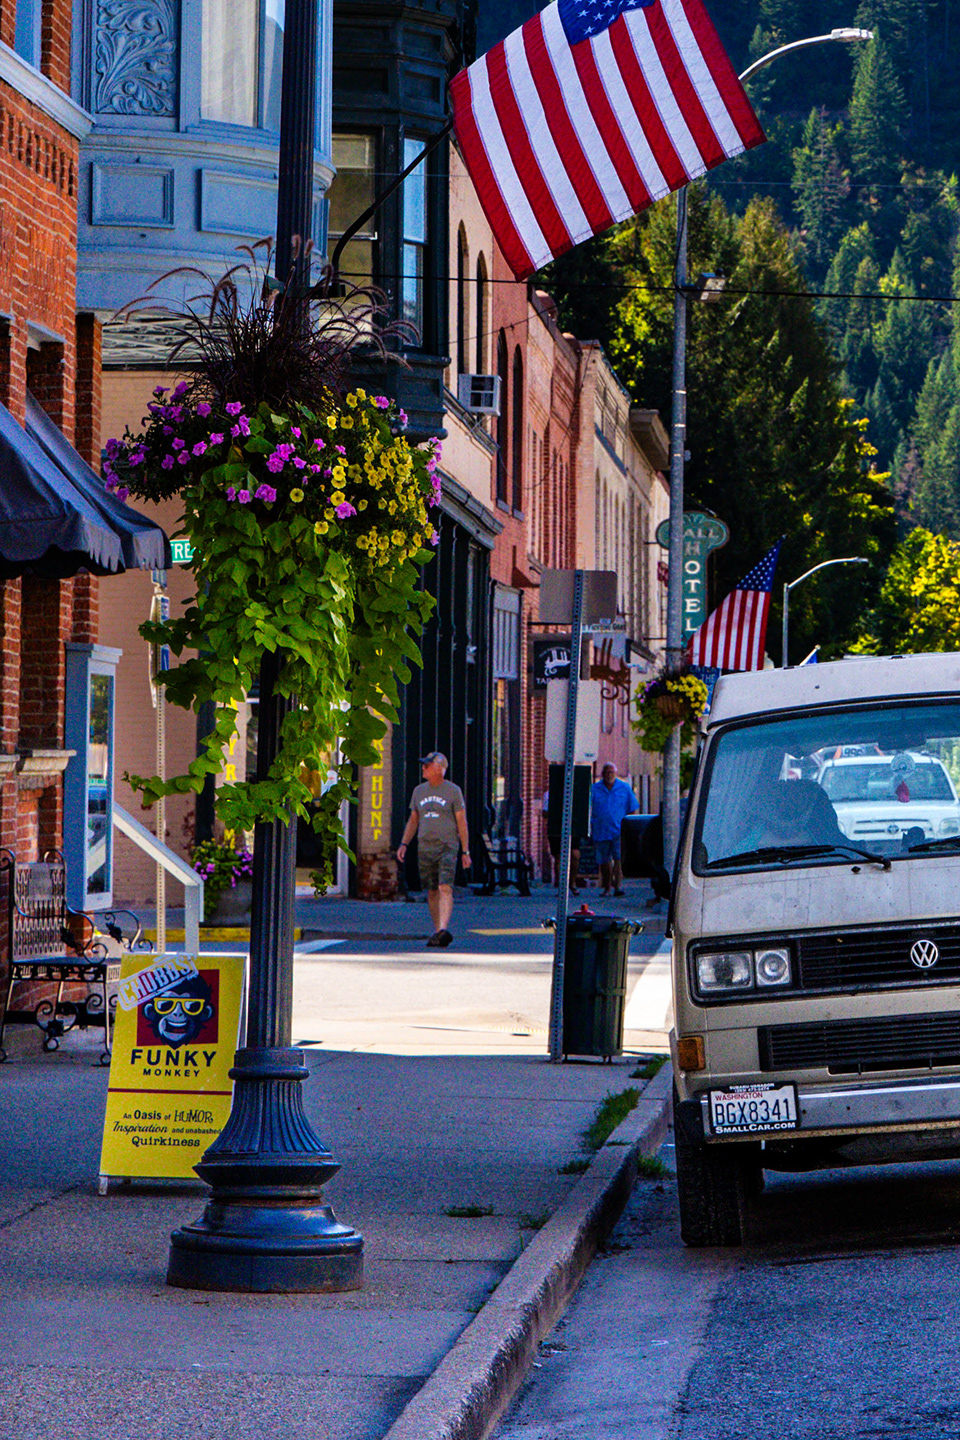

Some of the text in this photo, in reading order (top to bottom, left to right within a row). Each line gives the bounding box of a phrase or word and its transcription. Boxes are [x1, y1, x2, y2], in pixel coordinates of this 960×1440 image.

[683, 528, 720, 539] ALL
[684, 541, 701, 632] HOTEL
[120, 959, 192, 1004] CHUBBS
[130, 1049, 217, 1067] FUNKY
[143, 1068, 201, 1077] MONKEY
[715, 1092, 763, 1101] WASHINGTON
[123, 1109, 214, 1124] An Oasis of HUMOR
[715, 1098, 789, 1126] BGX8341
[113, 1121, 168, 1135] Inspiration
[171, 1126, 184, 1134] and
[131, 1135, 201, 1148] Quirkiness
